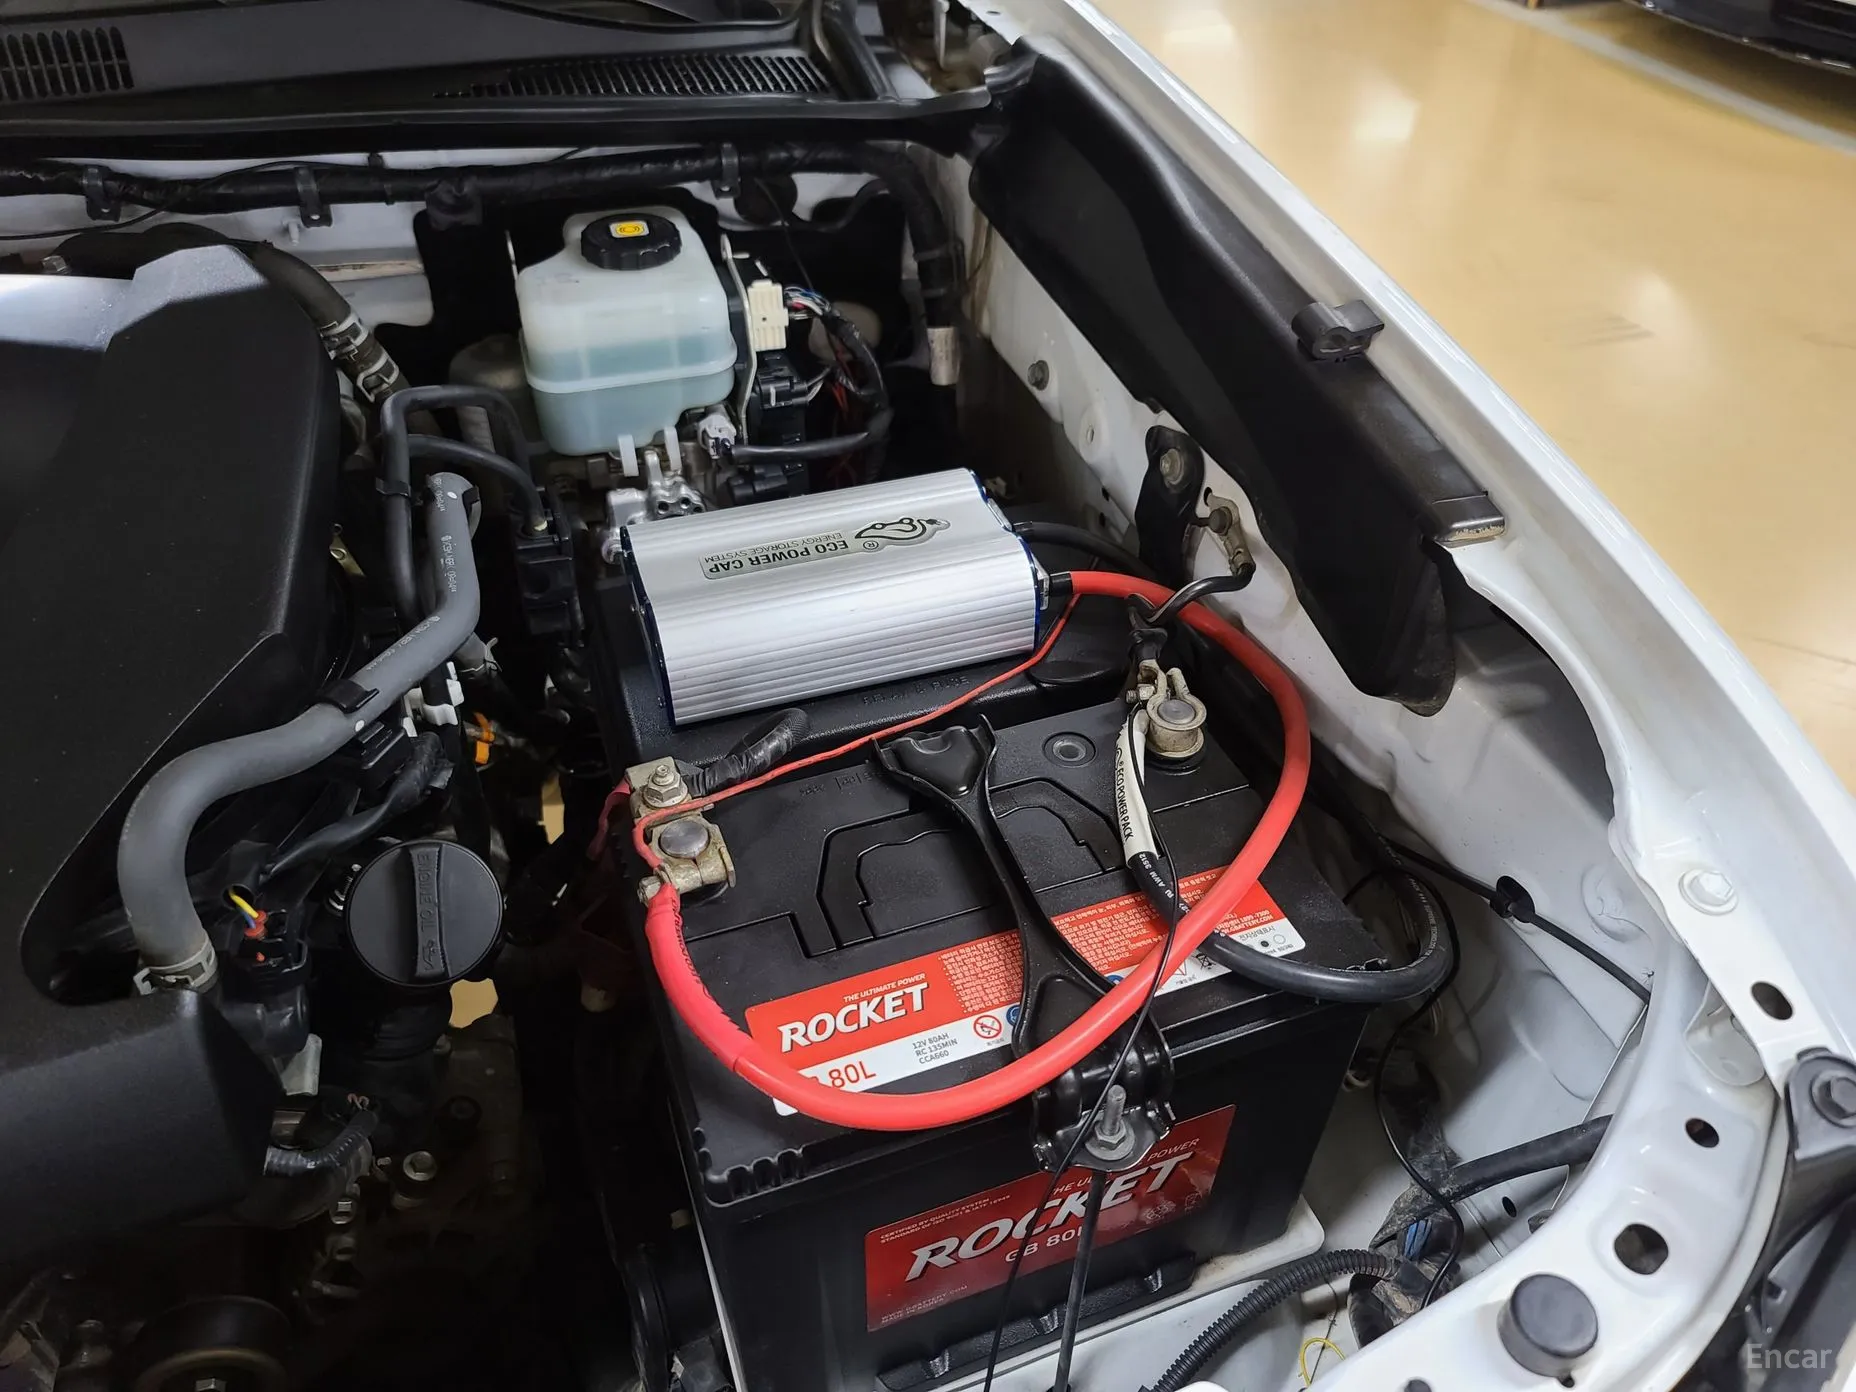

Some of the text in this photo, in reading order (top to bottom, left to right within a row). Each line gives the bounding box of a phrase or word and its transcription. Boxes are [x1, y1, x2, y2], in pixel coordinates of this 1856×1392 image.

[704, 532, 843, 563] ENERGY STORAGE SYSTEM
[709, 540, 849, 574] ECO POWER CAP
[1116, 767, 1134, 842] ECO POWER PACK
[1138, 853, 1152, 870] 3512
[417, 853, 436, 932] ENGINE OIL
[1150, 871, 1166, 888] AWM
[843, 973, 926, 1003] THE ULTIMATE POWER
[777, 982, 930, 1054] ROCKET
[912, 1032, 950, 1050] 12V 80AH
[915, 1038, 958, 1057] RC 135MIN
[918, 1050, 950, 1065] CCA660
[828, 1060, 878, 1089] 80L
[1147, 1138, 1199, 1161] POWER
[905, 1151, 1194, 1282] ROCKET
[1005, 1243, 1039, 1263] GB
